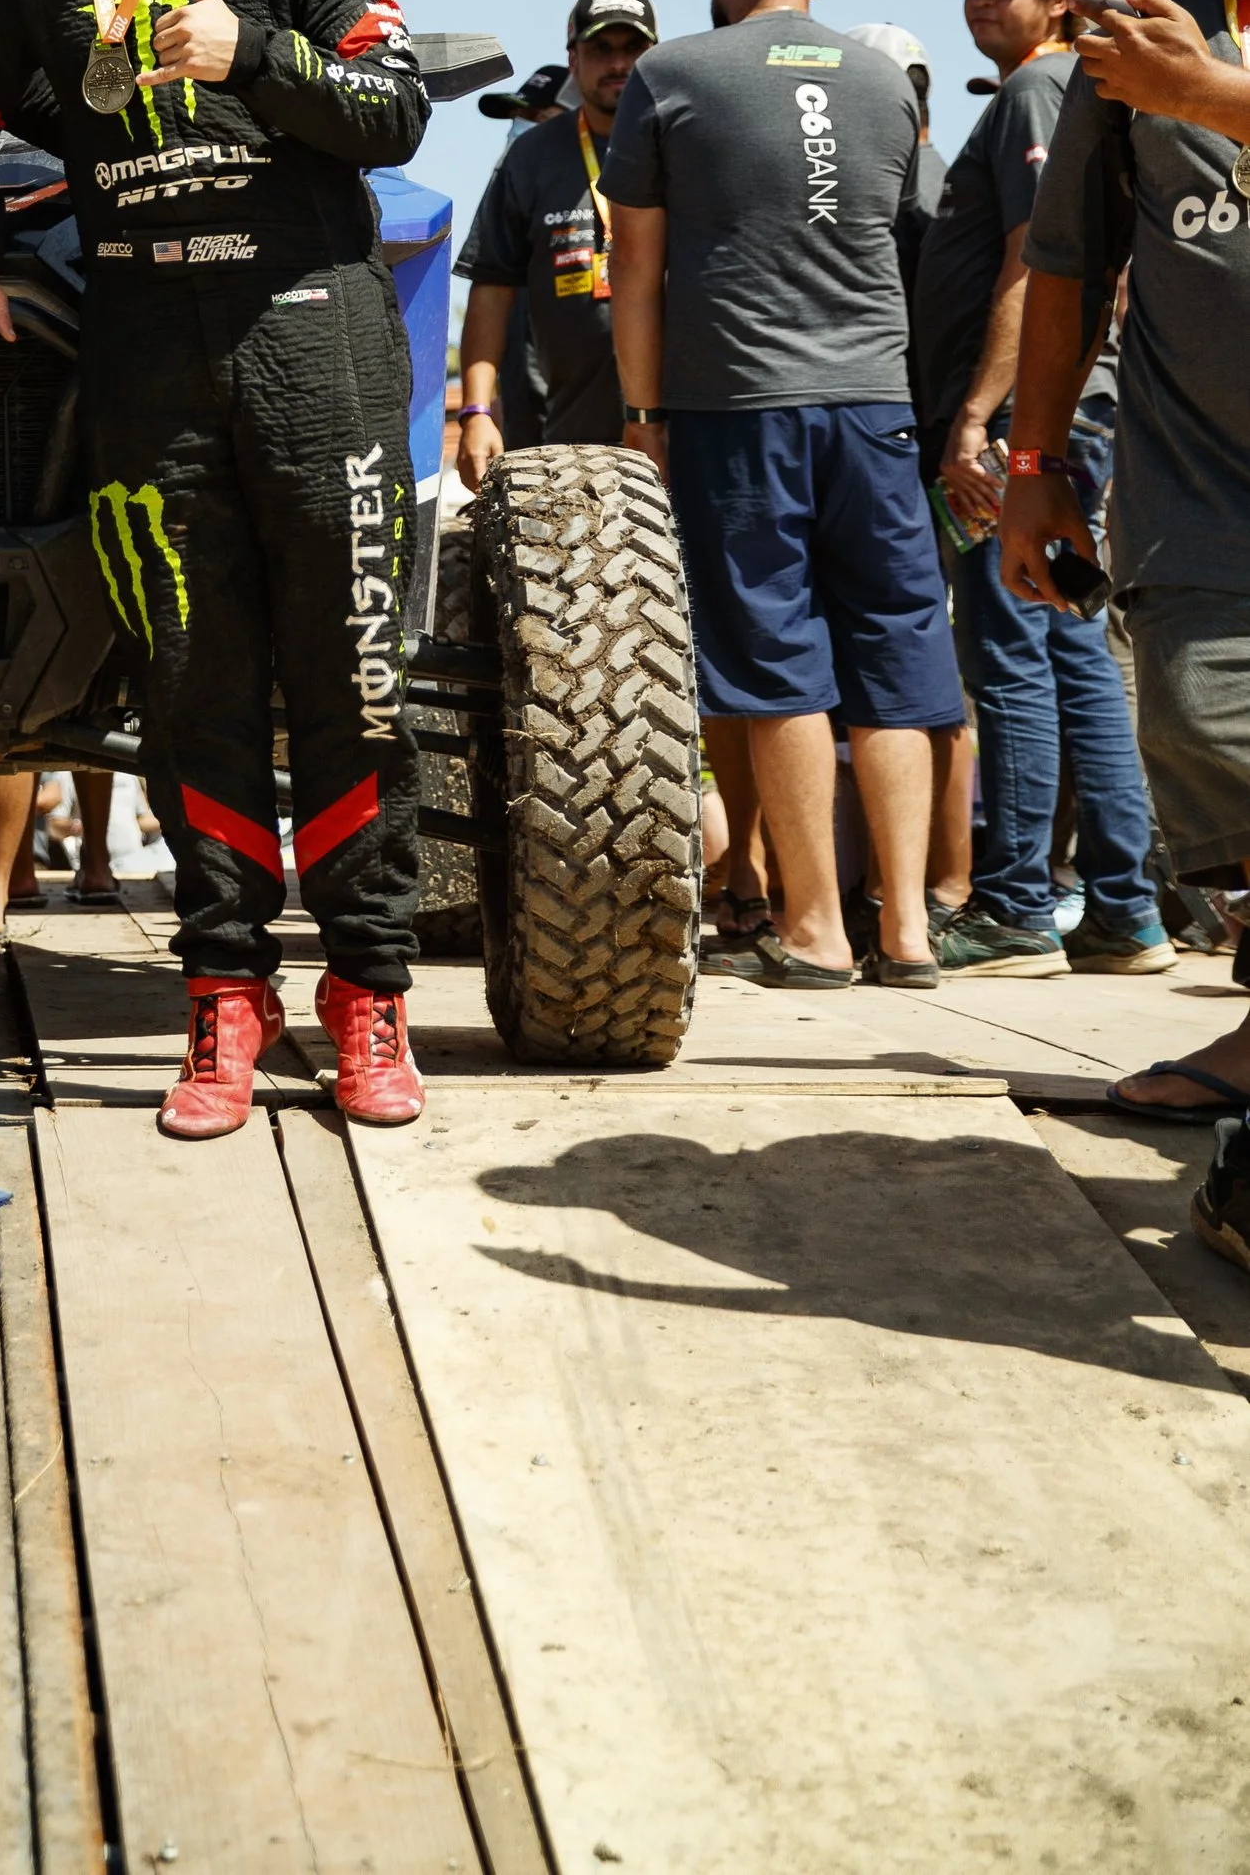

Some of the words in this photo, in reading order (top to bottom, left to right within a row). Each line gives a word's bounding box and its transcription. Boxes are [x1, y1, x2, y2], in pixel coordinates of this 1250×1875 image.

[111, 144, 271, 182] MAGPUL
[117, 175, 253, 208] NITTO
[97, 241, 134, 258] sparco
[187, 245, 258, 263] CURRIE
[344, 442, 402, 740] MONSTER
